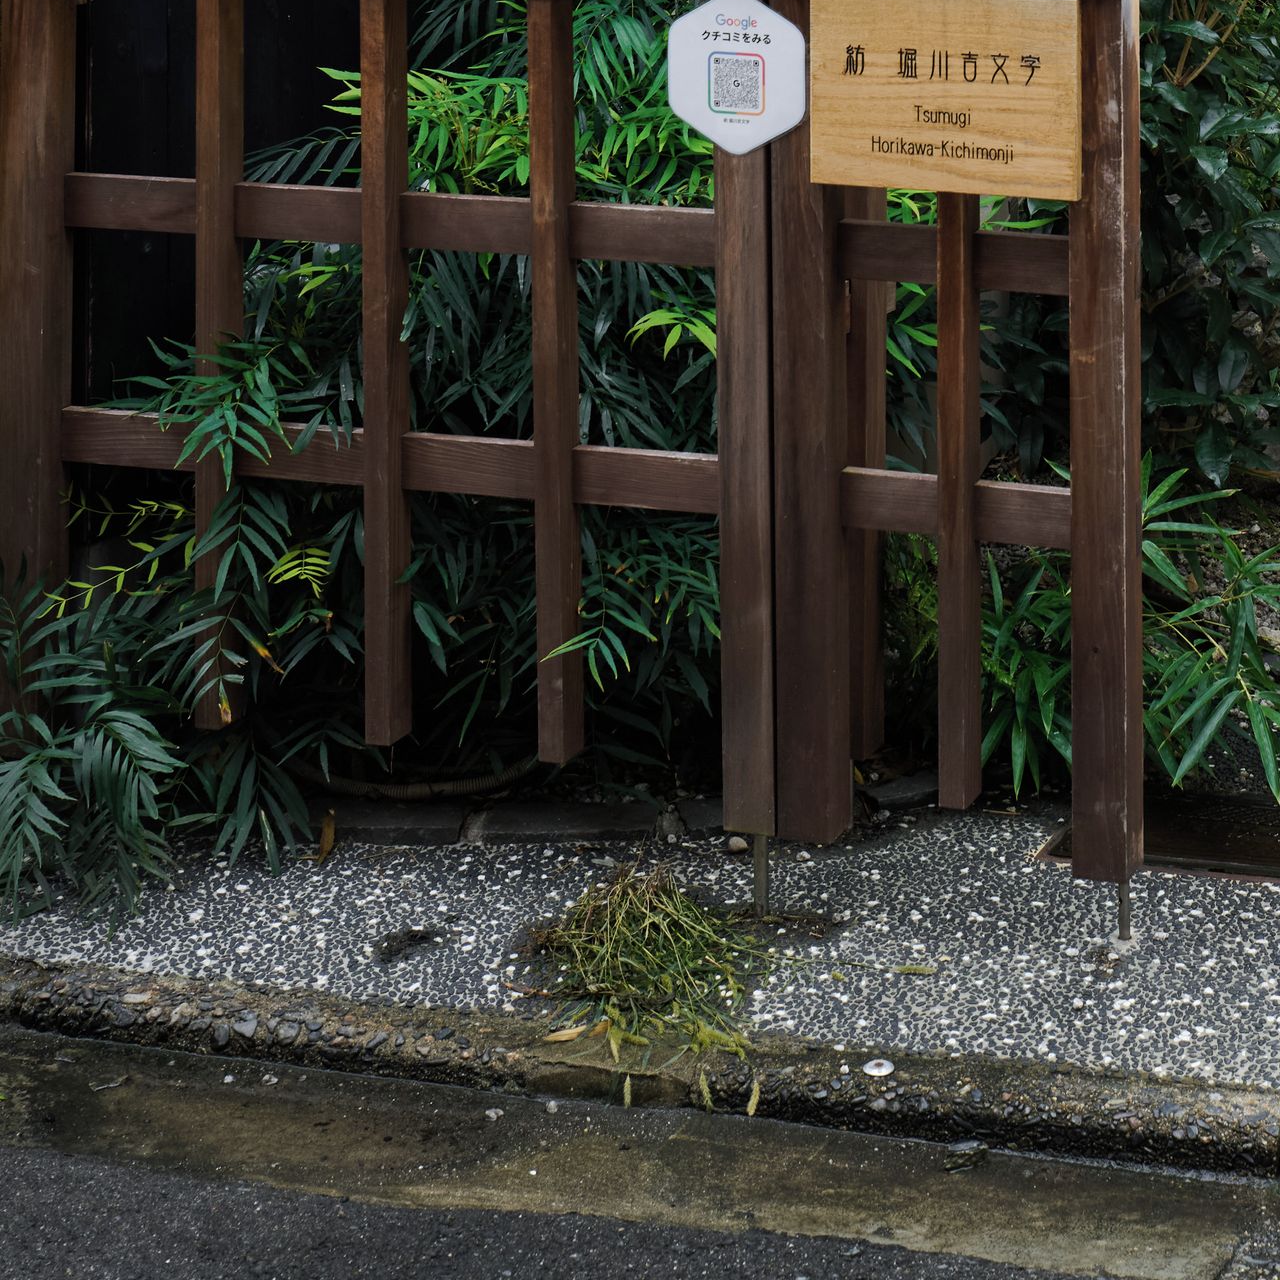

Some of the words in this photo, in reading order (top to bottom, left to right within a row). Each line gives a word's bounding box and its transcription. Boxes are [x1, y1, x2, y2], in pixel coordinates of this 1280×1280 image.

[715, 13, 758, 31] Google
[701, 30, 772, 45] クチコミをみる
[897, 47, 1041, 86] 堀川吉文字
[914, 105, 971, 128] Tsumugi
[871, 135, 1014, 164] Horikawa-Kichimonji
